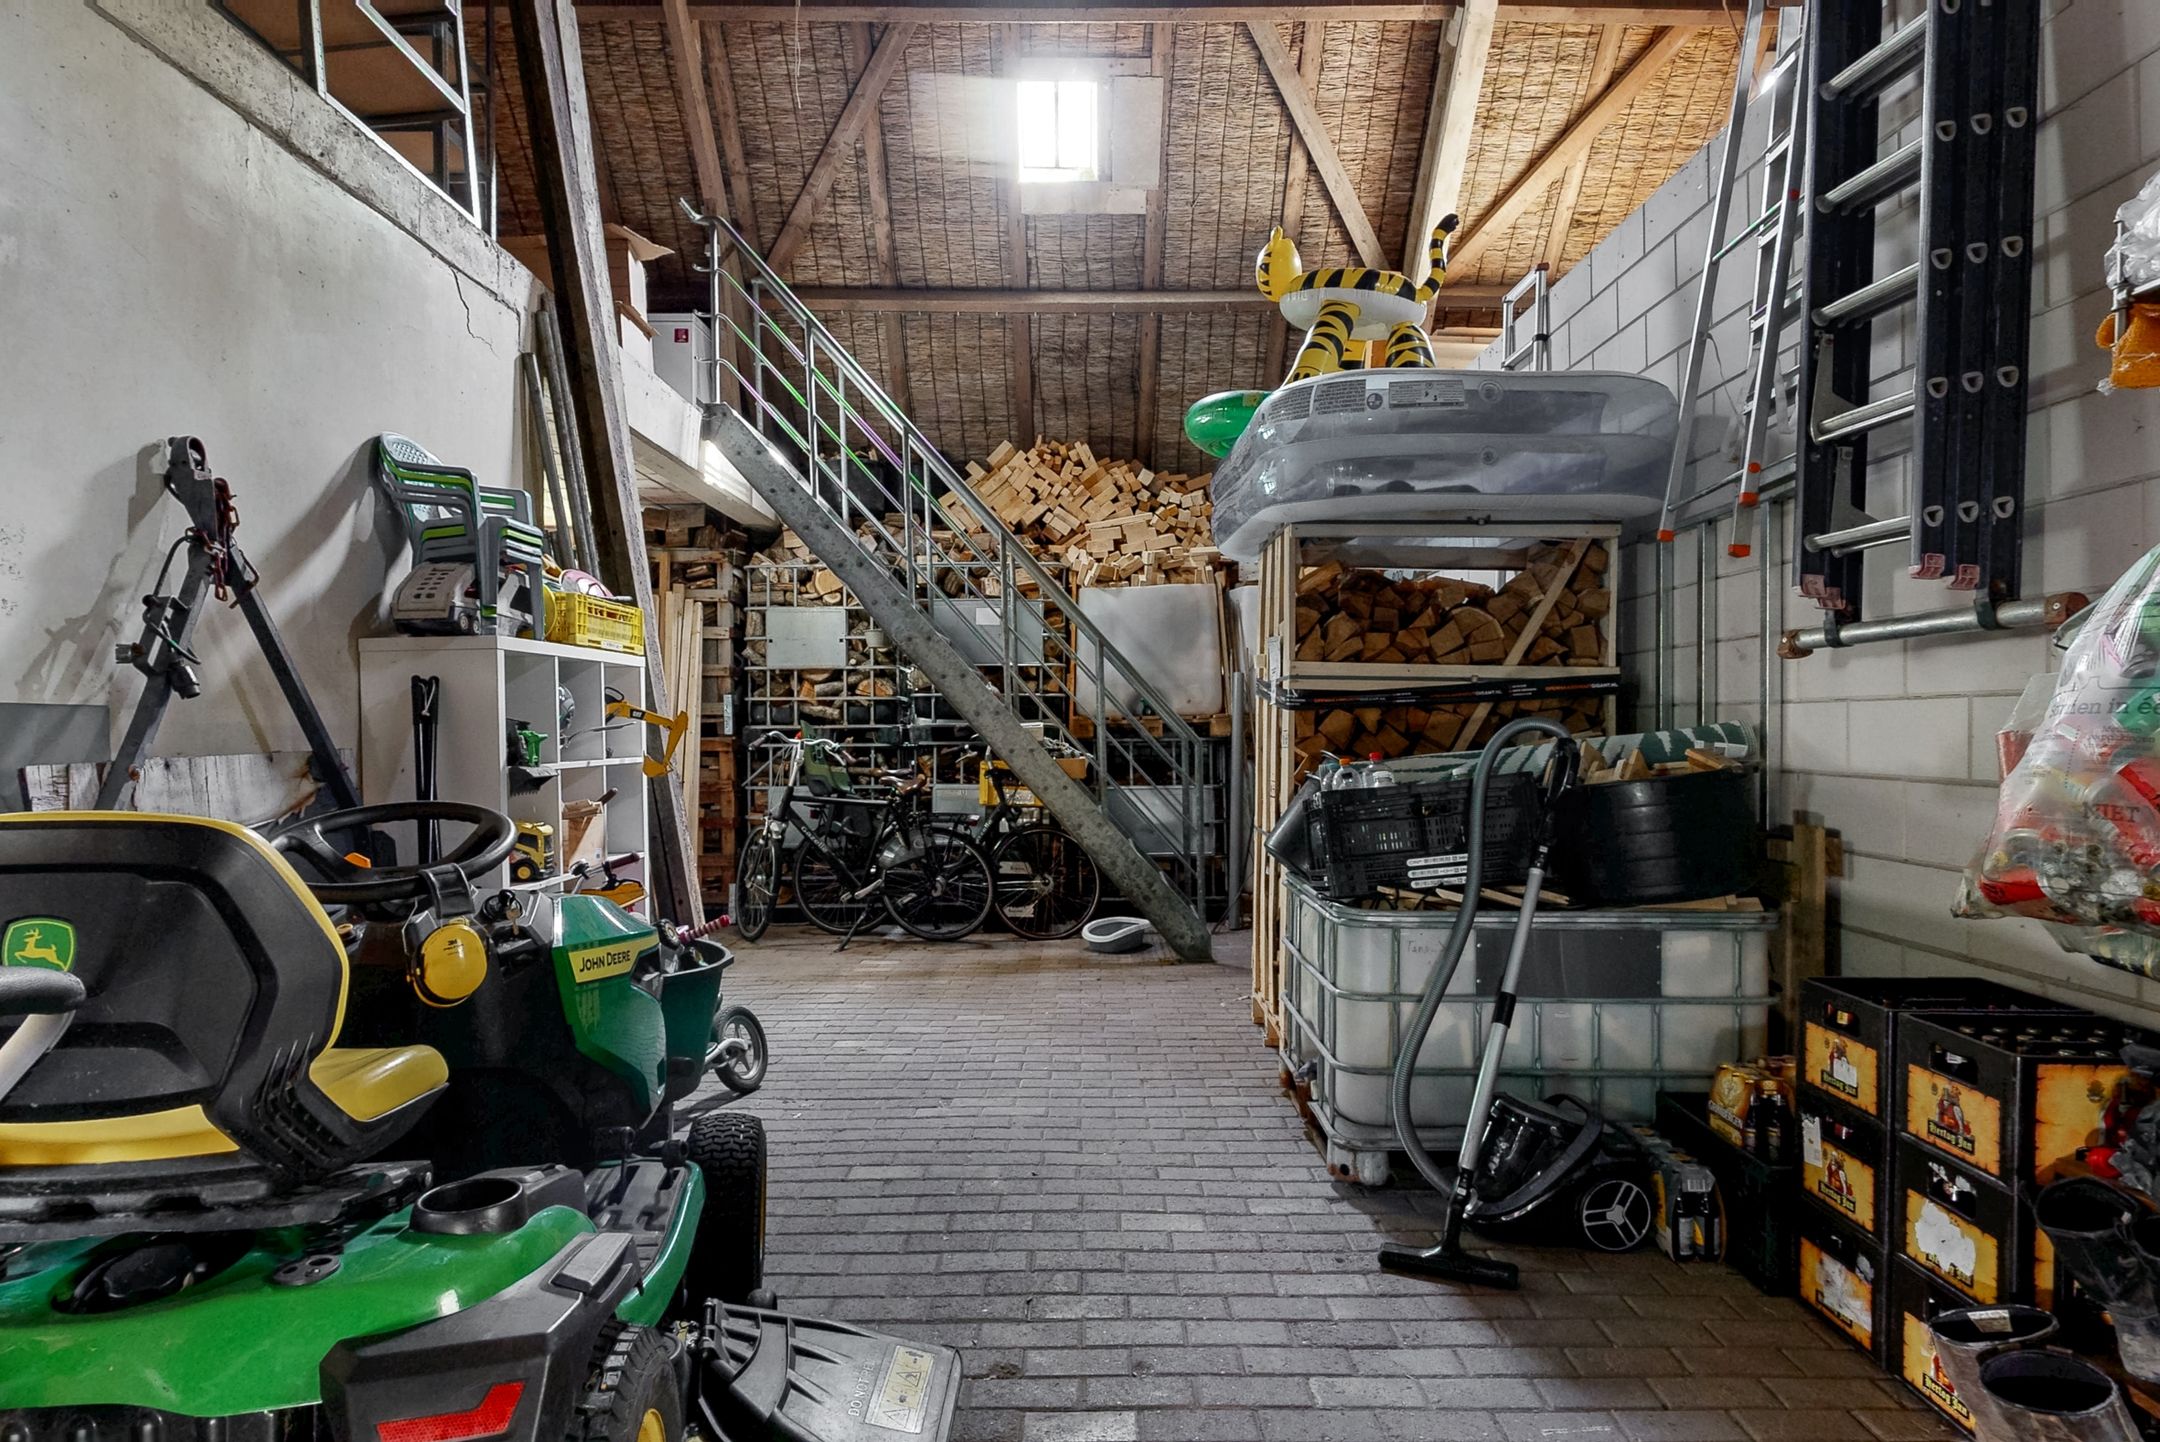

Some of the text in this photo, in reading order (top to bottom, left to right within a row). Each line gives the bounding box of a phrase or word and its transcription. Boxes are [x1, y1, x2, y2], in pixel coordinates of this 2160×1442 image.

[2082, 801, 2140, 823] NIET
[579, 950, 631, 972] JOHN DEERE
[1929, 1120, 1973, 1152] Hertog Jan
[853, 1377, 870, 1398] NOT
[1924, 1375, 1969, 1417] Hertog Jan
[847, 1400, 863, 1417] DO
